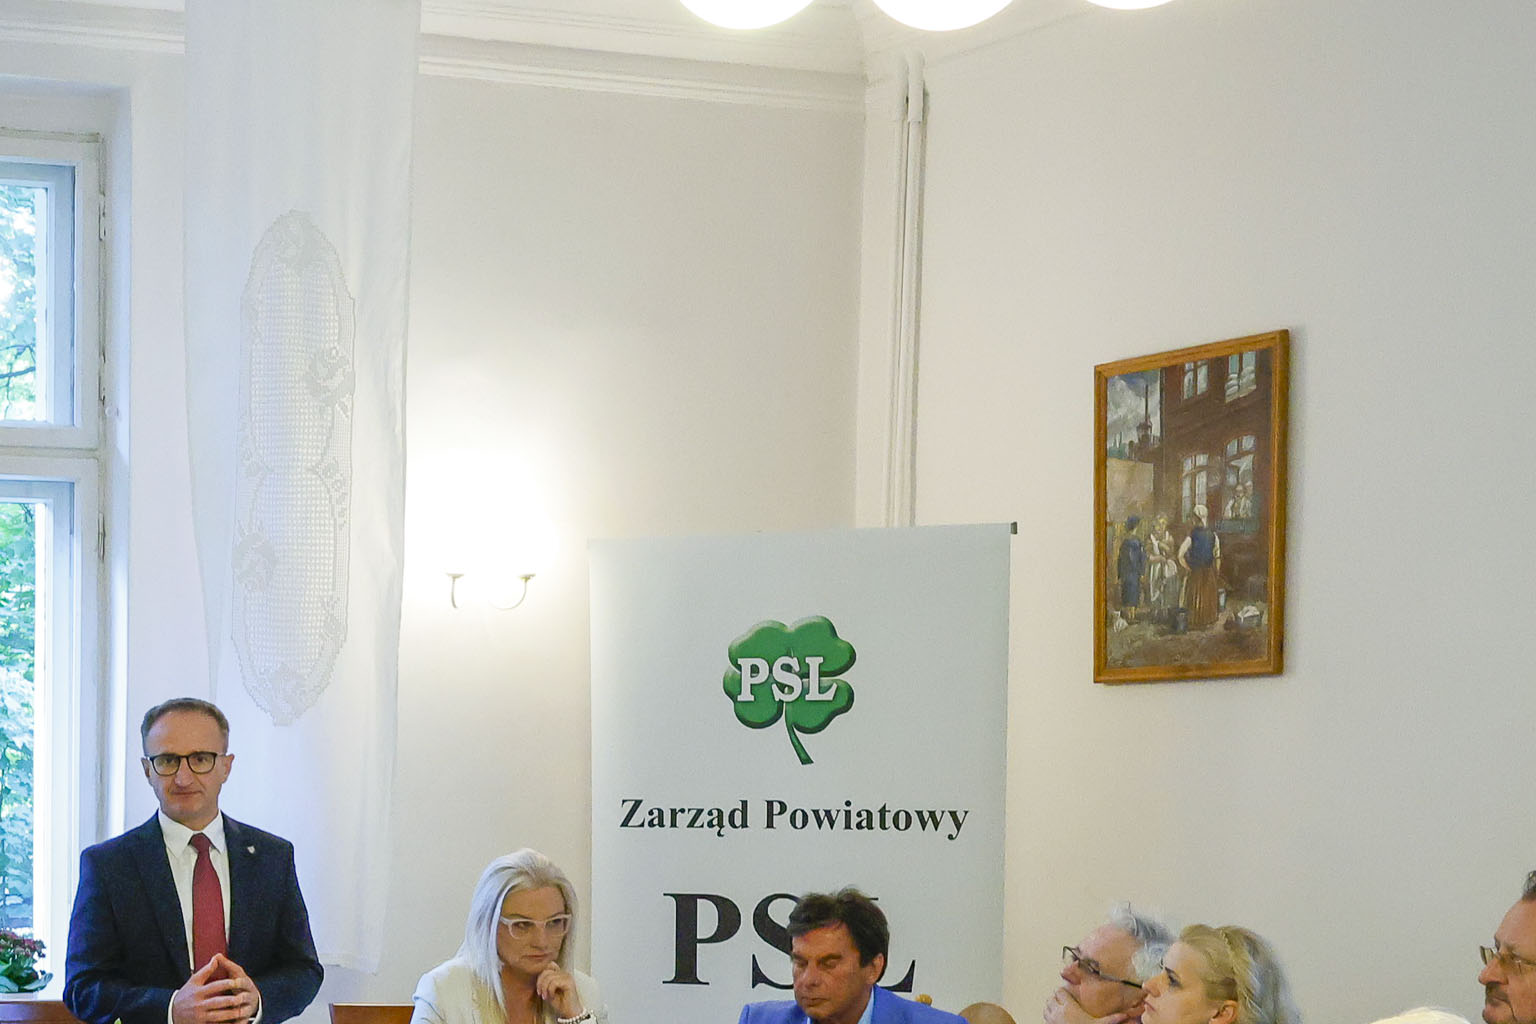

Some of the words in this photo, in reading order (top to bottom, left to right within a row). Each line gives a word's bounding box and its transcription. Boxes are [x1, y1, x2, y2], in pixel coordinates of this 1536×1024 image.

[737, 656, 837, 703] PSL
[620, 799, 748, 837] Zarząd
[765, 799, 970, 840] Powiatowy
[662, 893, 916, 993] PS
